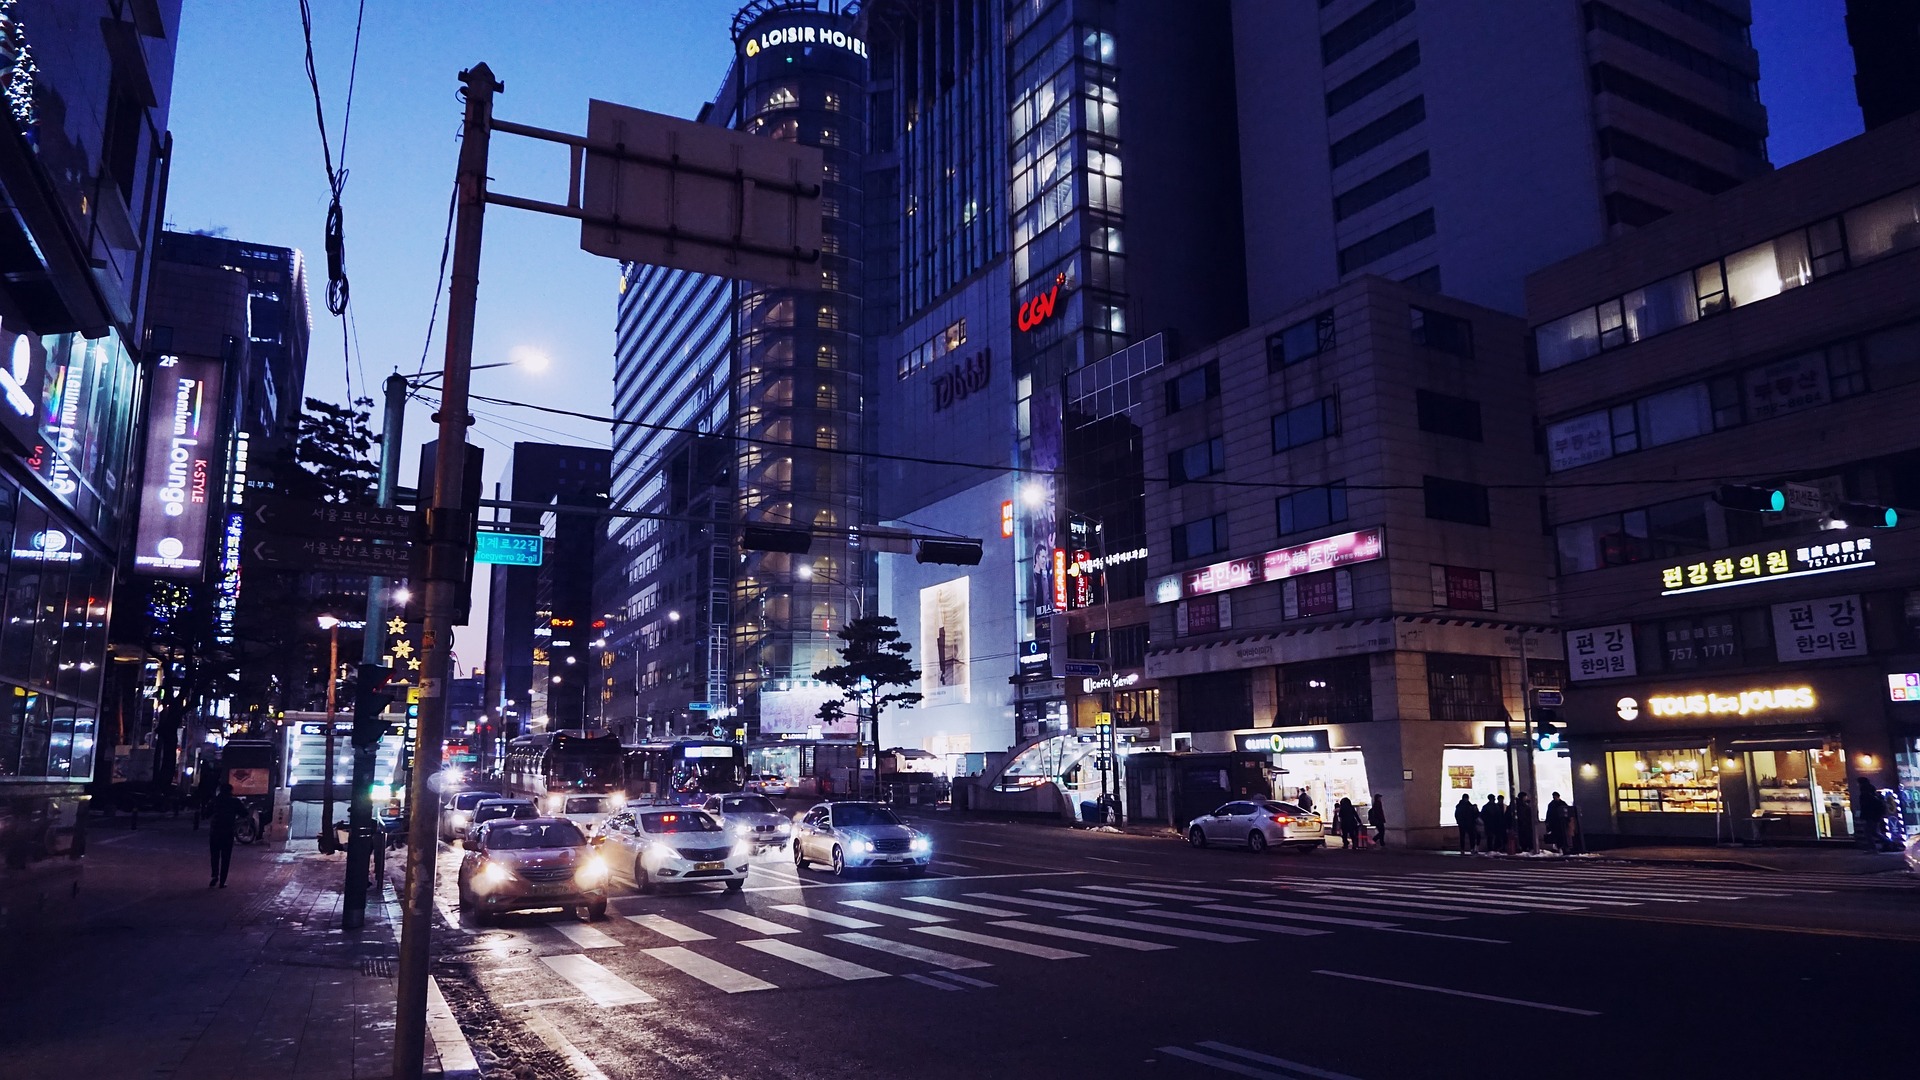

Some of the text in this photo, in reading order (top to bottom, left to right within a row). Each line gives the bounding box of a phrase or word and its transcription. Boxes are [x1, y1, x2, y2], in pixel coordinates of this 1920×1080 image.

[762, 27, 815, 49] LOISIR
[1018, 285, 1058, 332] CGV
[159, 355, 179, 368] 2F
[1755, 370, 1817, 400] 부동산
[159, 378, 198, 516] Premium Lounge
[1556, 430, 1601, 454] 부동산
[191, 459, 207, 503] K-STYLE
[311, 508, 410, 528] 서울프린스호텔
[303, 541, 410, 561] 서울남산초등학교
[1808, 552, 1864, 568] 757-1717
[1187, 562, 1261, 593] 규림한의원
[1662, 549, 1789, 589] 편강한의원
[1795, 630, 1857, 654] 한의원
[1580, 655, 1626, 674] 한의원
[1649, 687, 1814, 716] TOUS les JOURS
